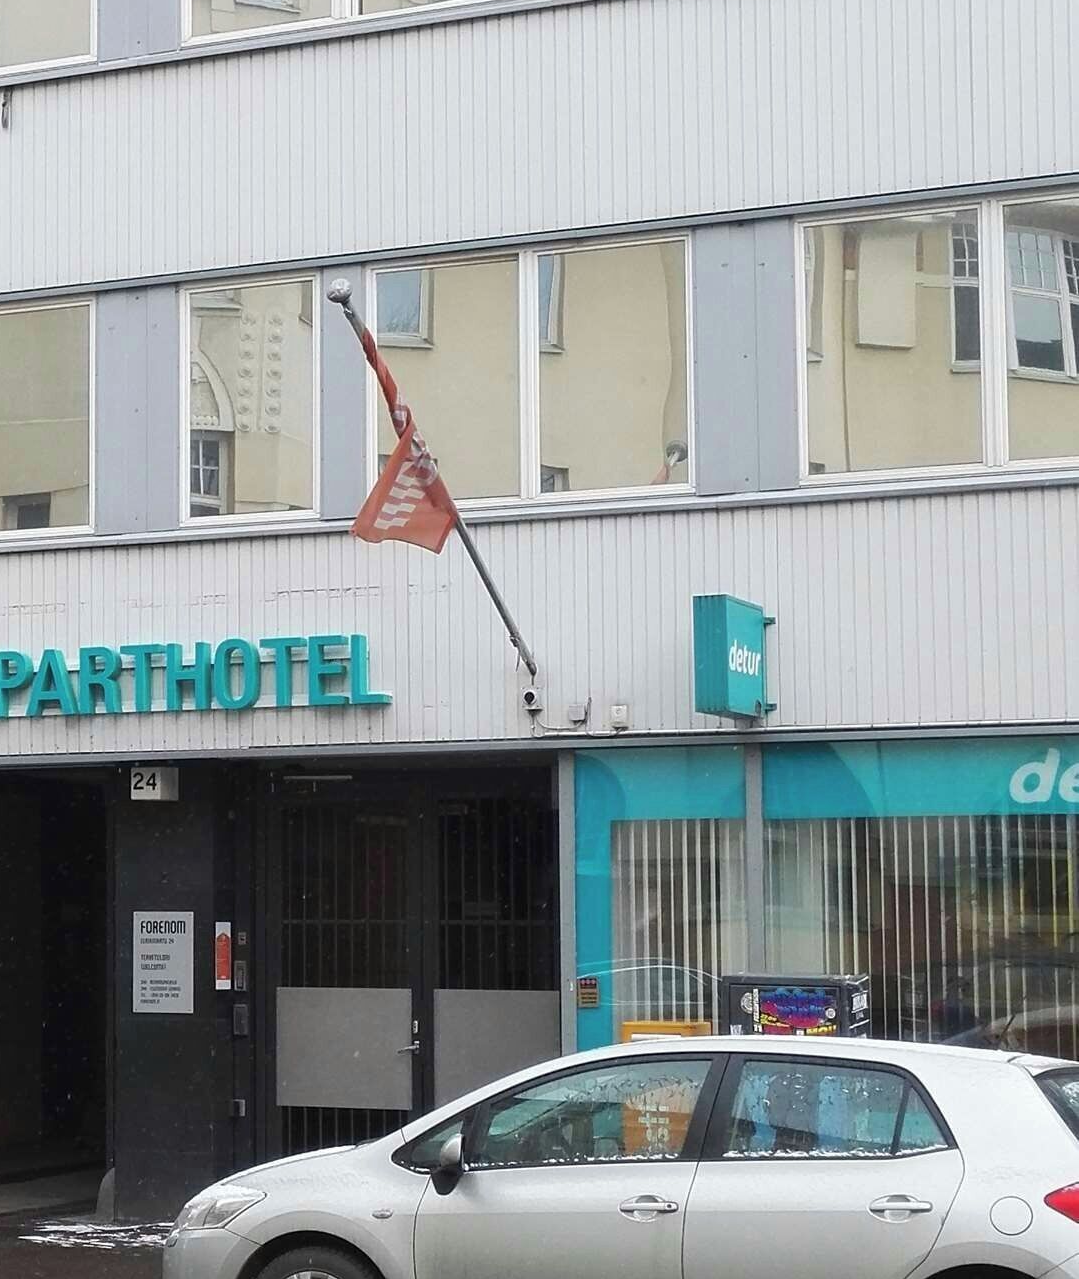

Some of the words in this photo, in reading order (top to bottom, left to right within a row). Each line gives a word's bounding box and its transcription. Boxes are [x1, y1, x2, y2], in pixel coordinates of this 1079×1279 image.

[729, 639, 761, 676] detur
[132, 771, 157, 791] 24
[140, 920, 186, 934] FORENOM
